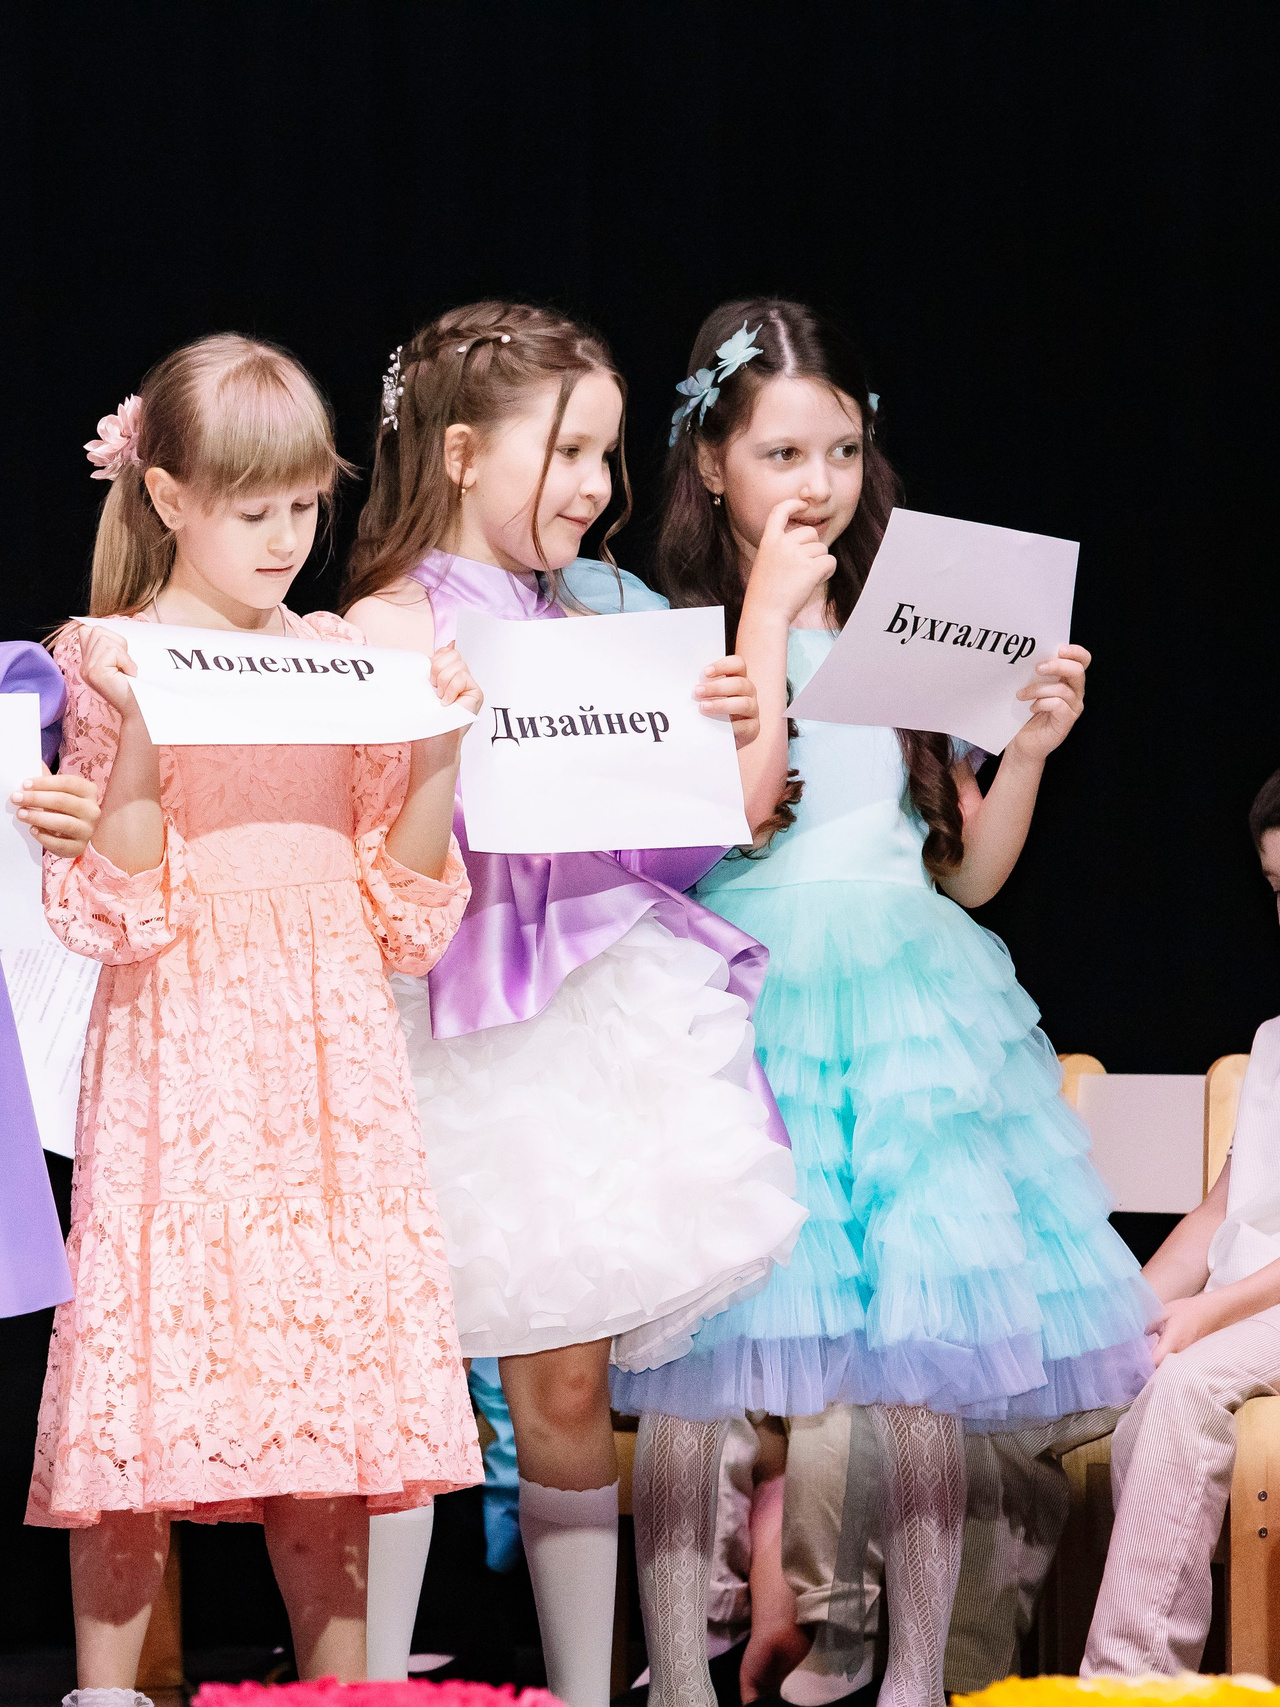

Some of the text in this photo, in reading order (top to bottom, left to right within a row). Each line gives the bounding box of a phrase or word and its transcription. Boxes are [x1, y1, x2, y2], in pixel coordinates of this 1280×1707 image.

[882, 601, 1037, 665] Бухгалтер
[166, 647, 375, 682] Модельер
[489, 704, 670, 747] Дизайнер
